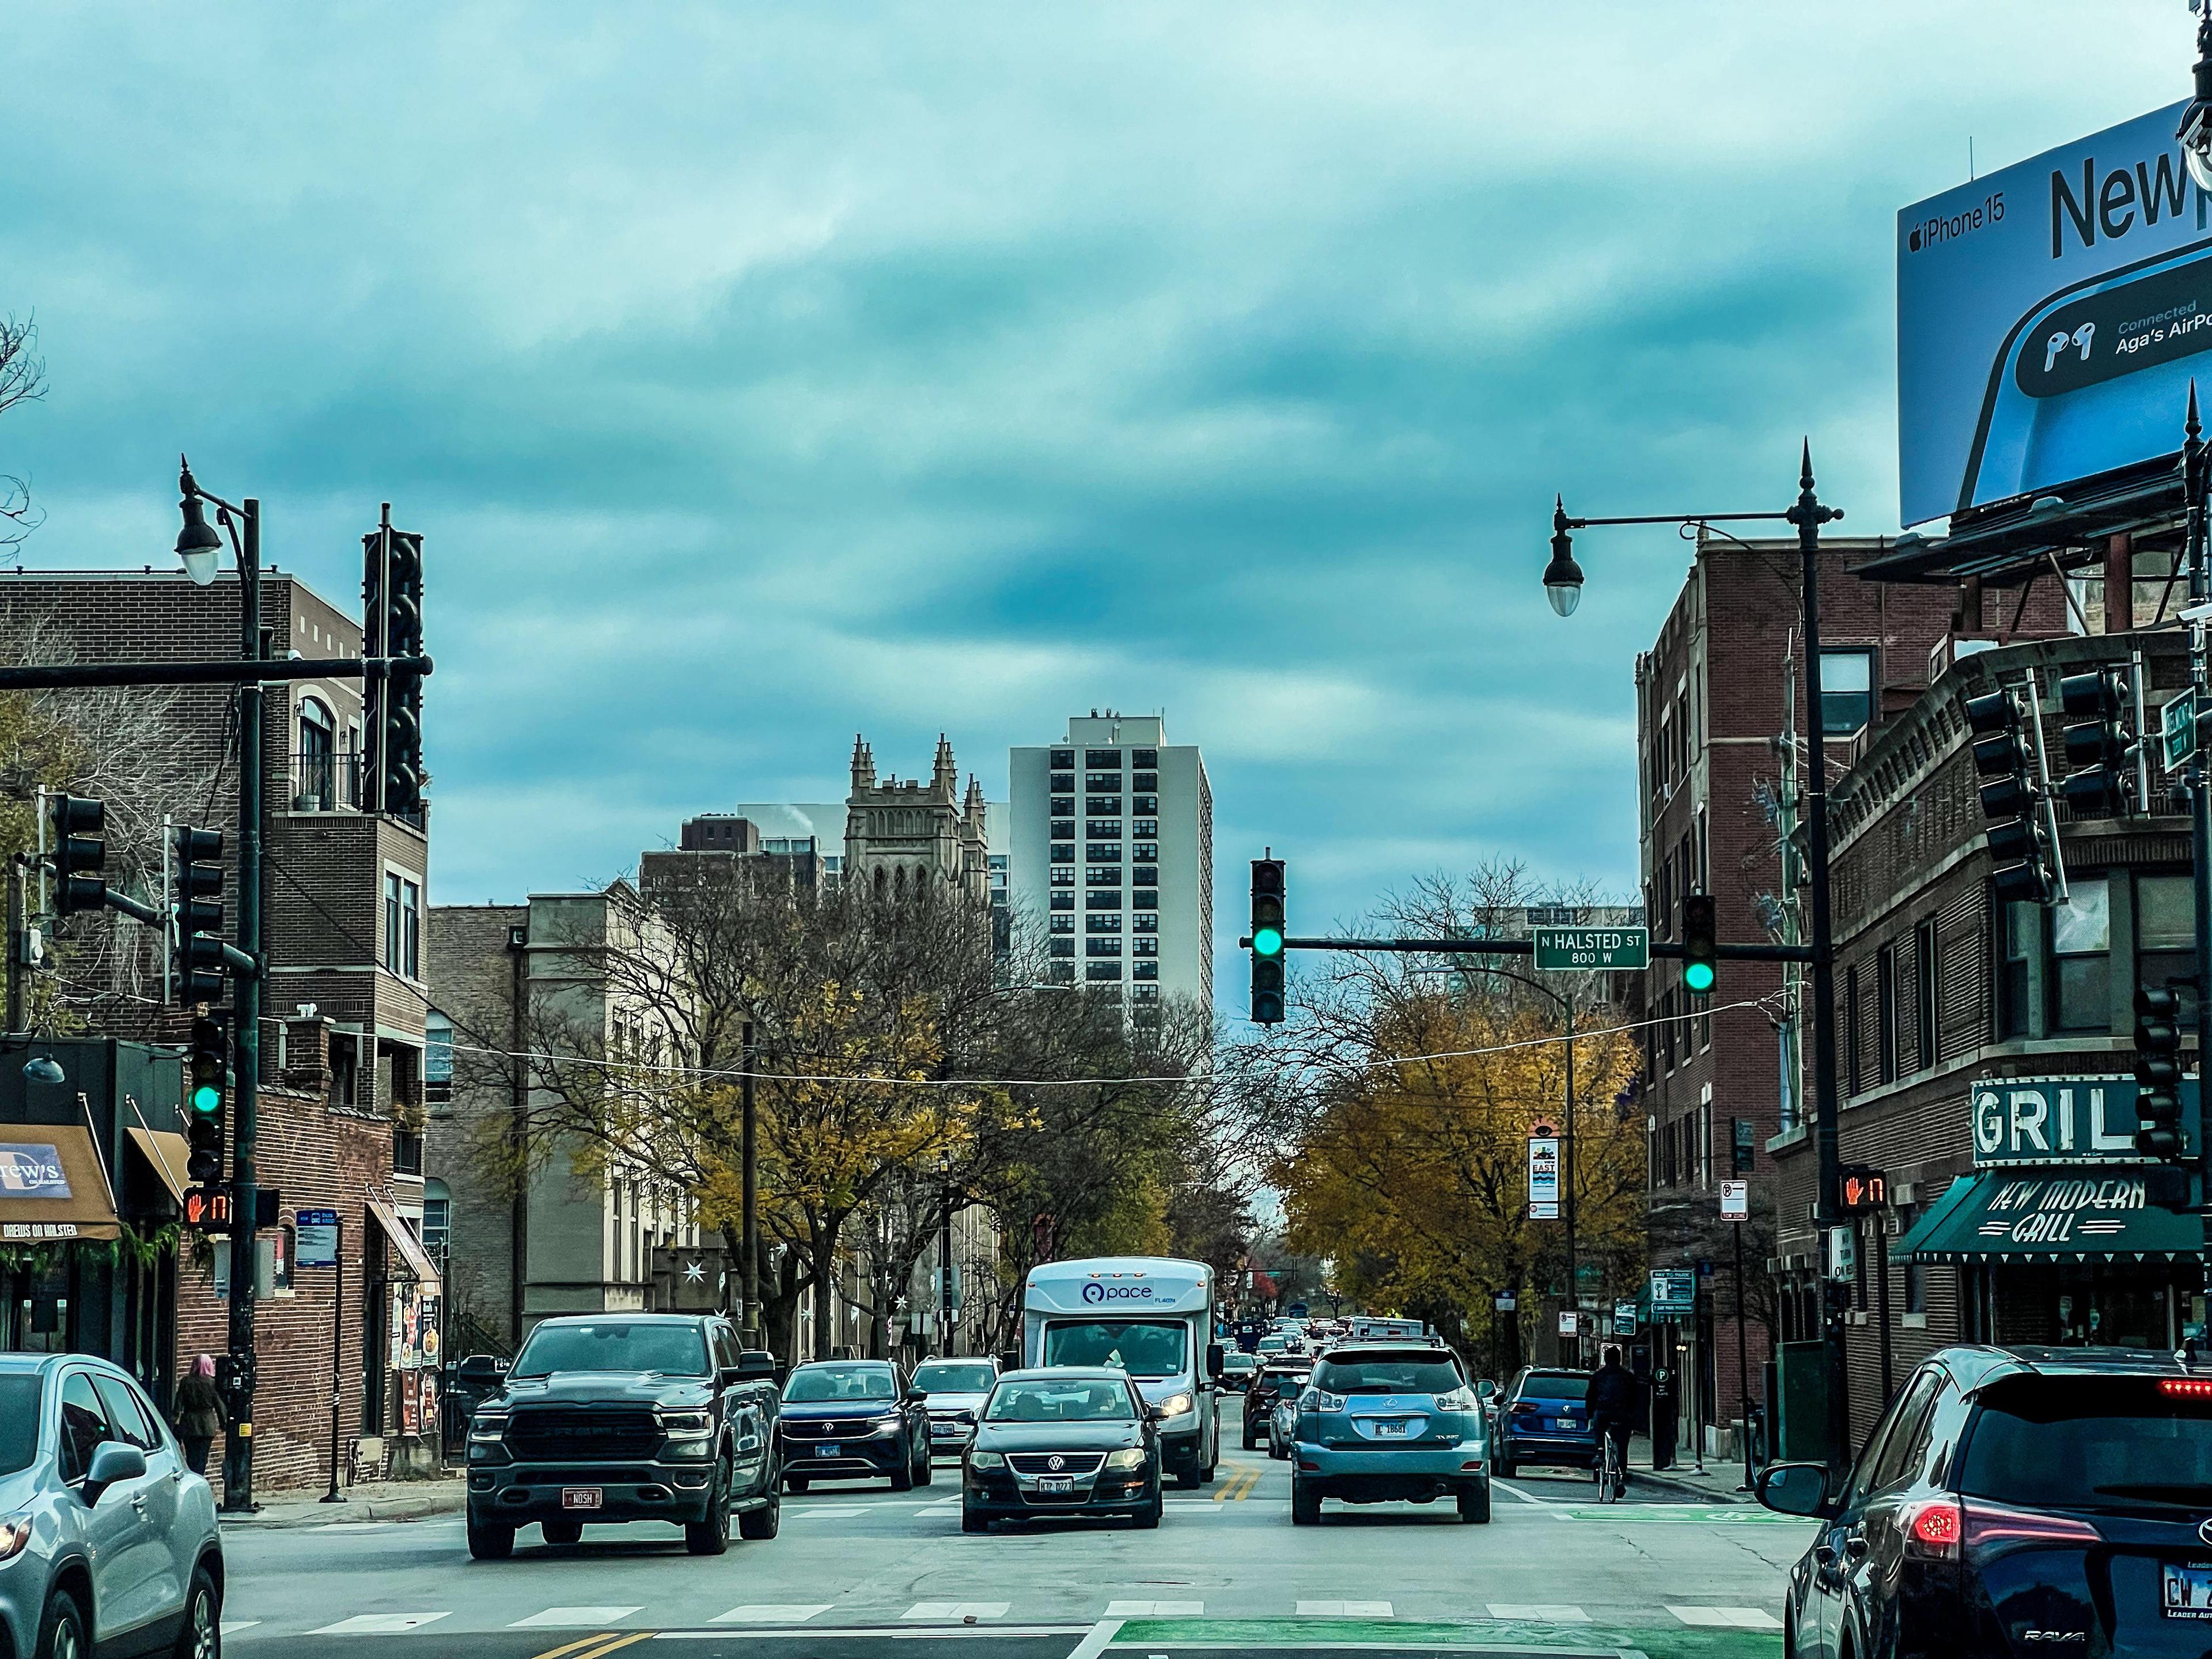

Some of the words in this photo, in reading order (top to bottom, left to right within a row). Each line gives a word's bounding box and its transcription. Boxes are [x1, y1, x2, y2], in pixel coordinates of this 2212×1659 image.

[1924, 208, 1982, 248] iPhone
[1986, 192, 2005, 224] 15
[2118, 300, 2196, 334] Connected
[2115, 329, 2164, 354] Aga's
[1541, 936, 1550, 946] N
[1555, 934, 1621, 949] HALSTED
[1627, 935, 1641, 946] ST
[1572, 952, 1595, 963] 800
[1603, 952, 1611, 963] W
[1974, 1088, 2188, 1153] GRIL
[1869, 1178, 1883, 1201] 17
[1987, 1180, 2042, 1210] NEW
[2038, 1180, 2145, 1210] MODERN
[211, 1196, 226, 1219] 17
[44, 1224, 77, 1237] HALSTED
[2012, 1213, 2074, 1242] GRILL
[1107, 1287, 1152, 1301] pace
[2167, 1578, 2191, 1606] CW
[2024, 1630, 2085, 1642] RAV4
